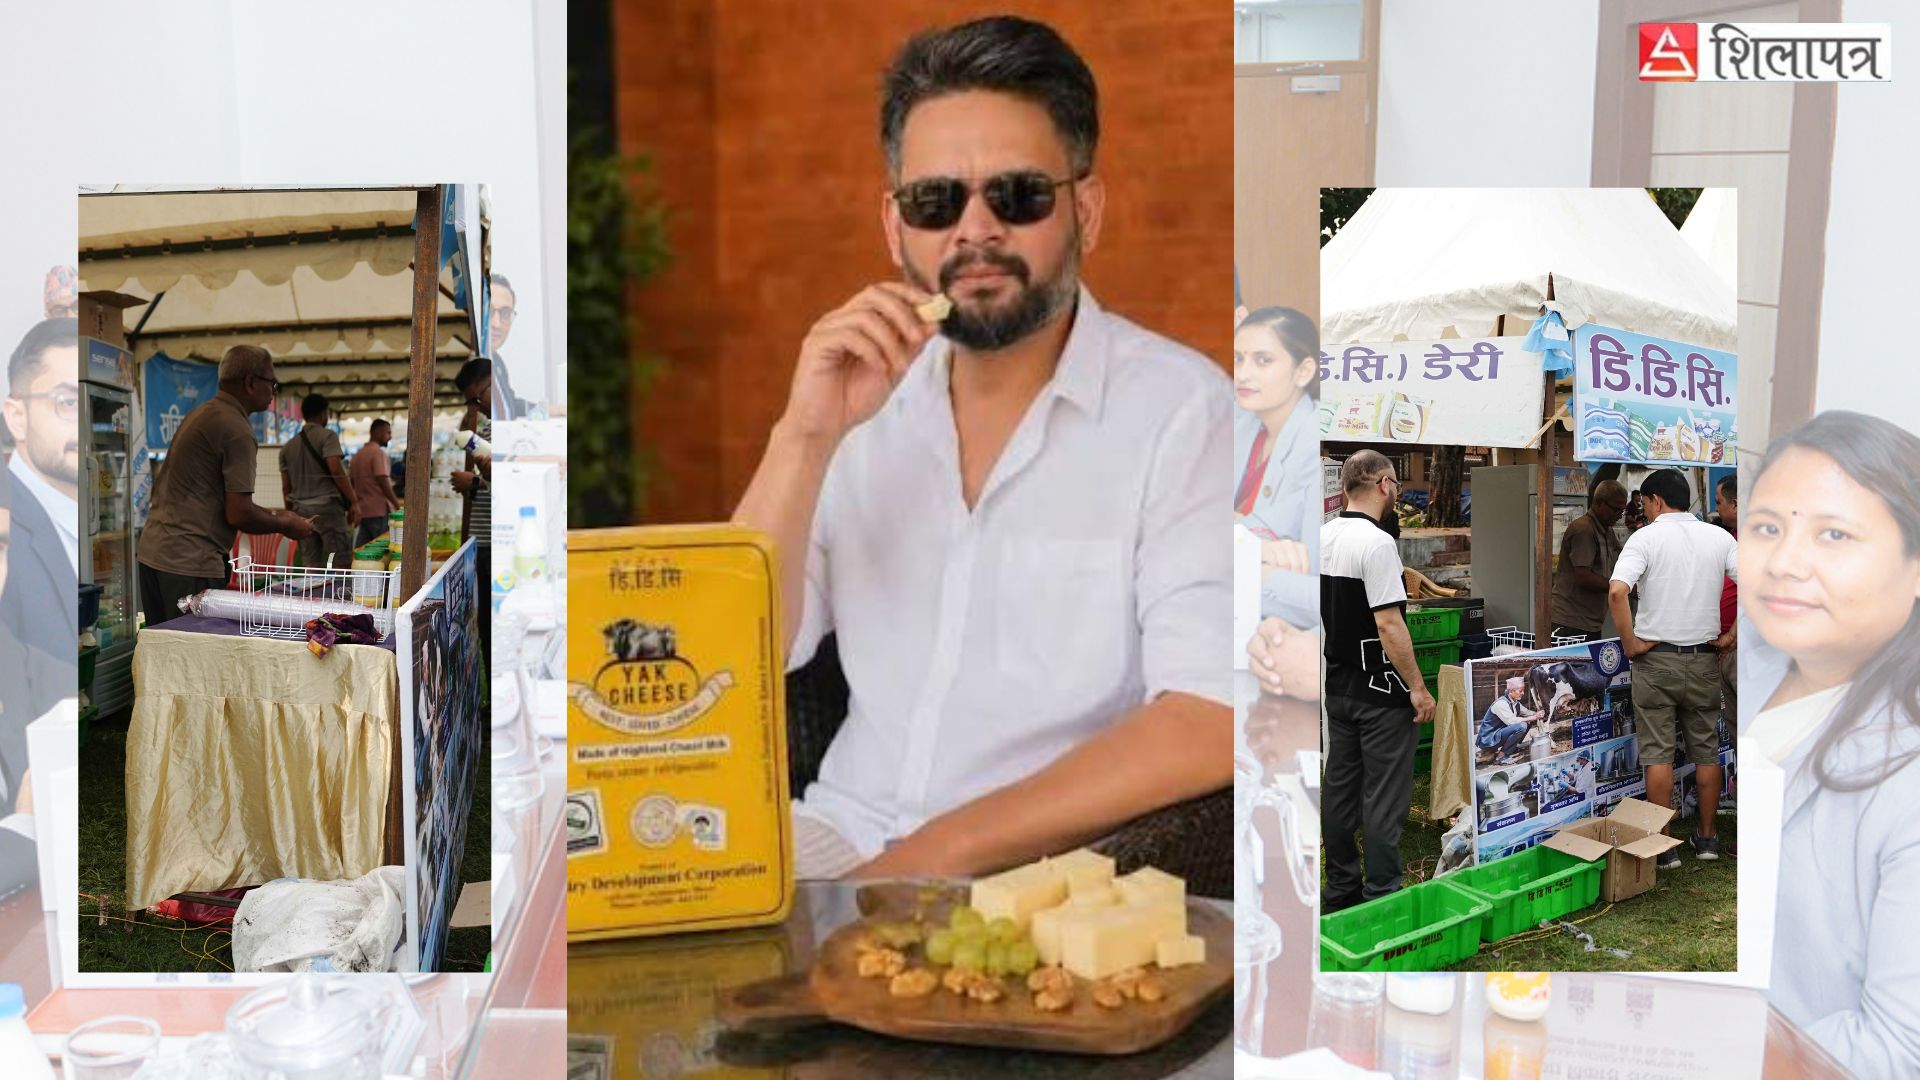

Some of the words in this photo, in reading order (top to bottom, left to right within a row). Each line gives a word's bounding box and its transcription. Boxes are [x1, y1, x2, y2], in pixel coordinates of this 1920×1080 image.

[1423, 342, 1504, 382] डेरी
[622, 664, 667, 683] YAK
[609, 683, 689, 706] CHEESE
[609, 746, 619, 757] of
[592, 870, 681, 890] Development
[685, 863, 767, 883] Corporation
